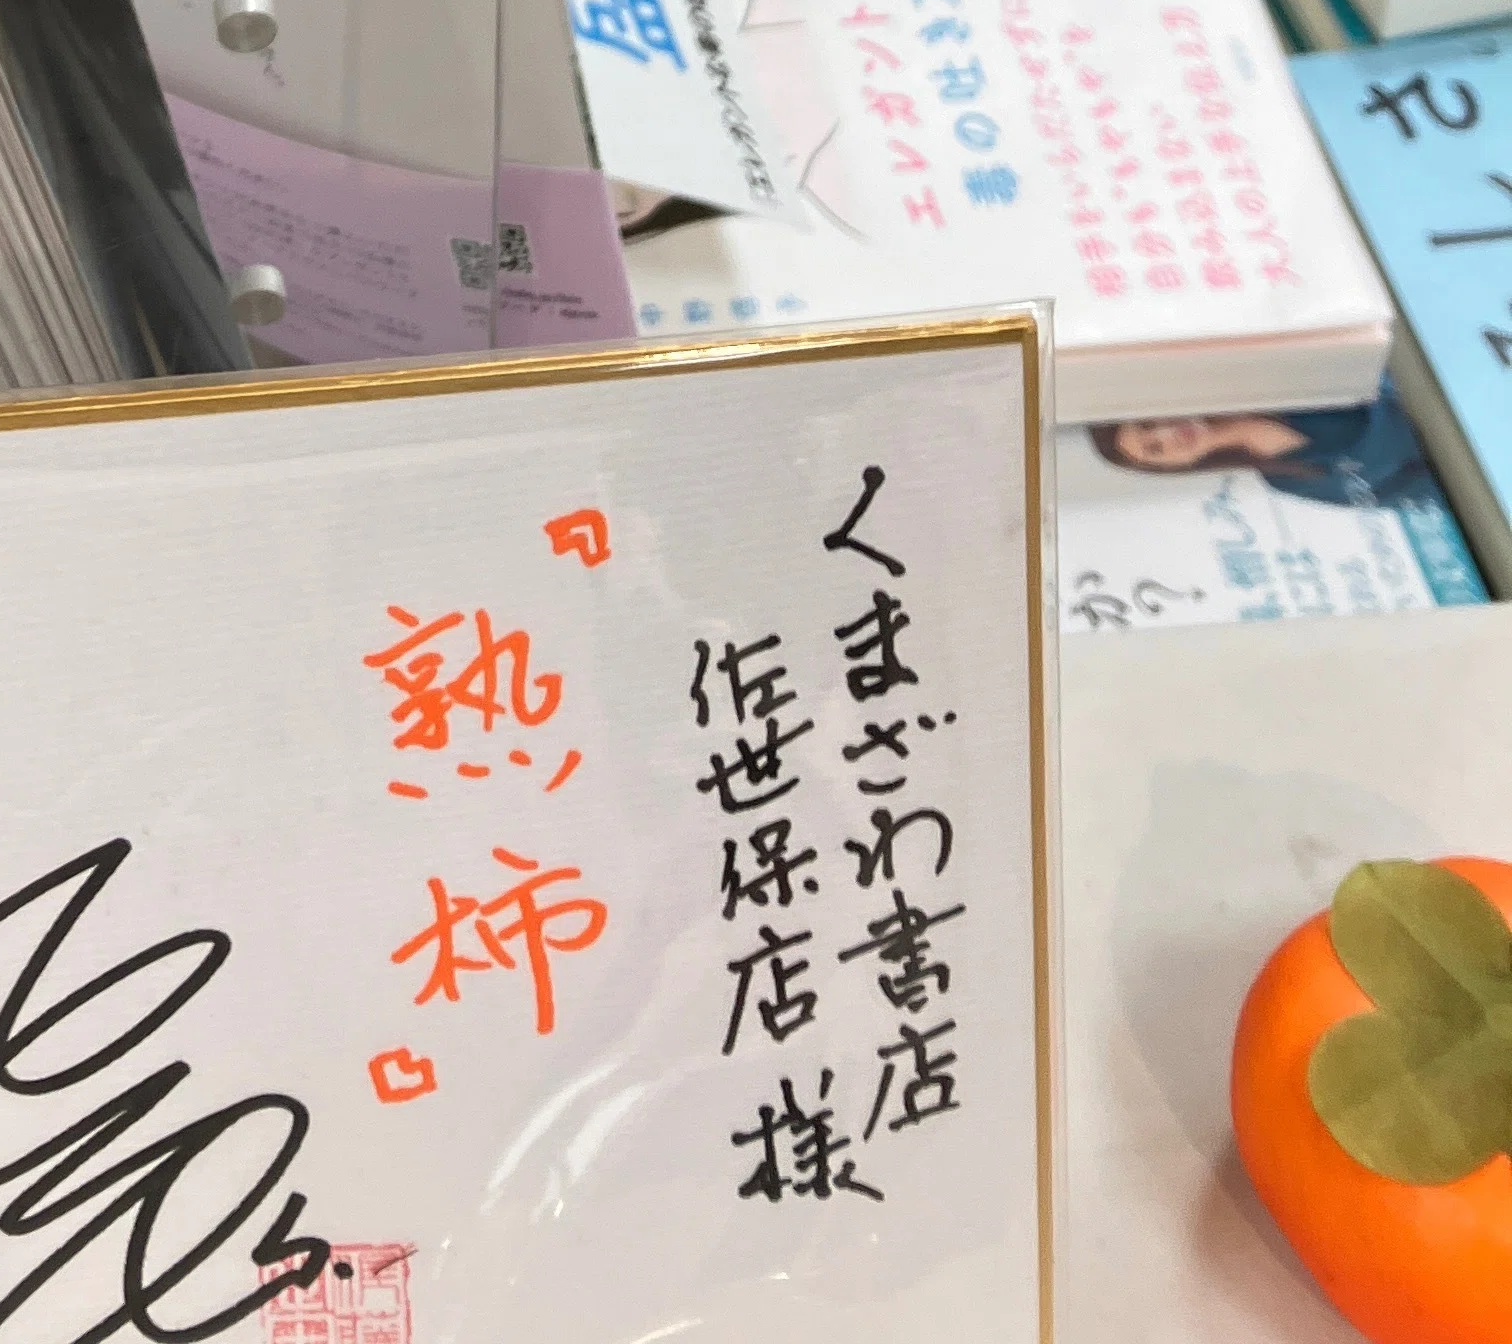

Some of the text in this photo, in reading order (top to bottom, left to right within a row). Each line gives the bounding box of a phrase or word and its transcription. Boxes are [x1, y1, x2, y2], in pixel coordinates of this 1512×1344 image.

[823, 465, 967, 1141] くまざわ書店
